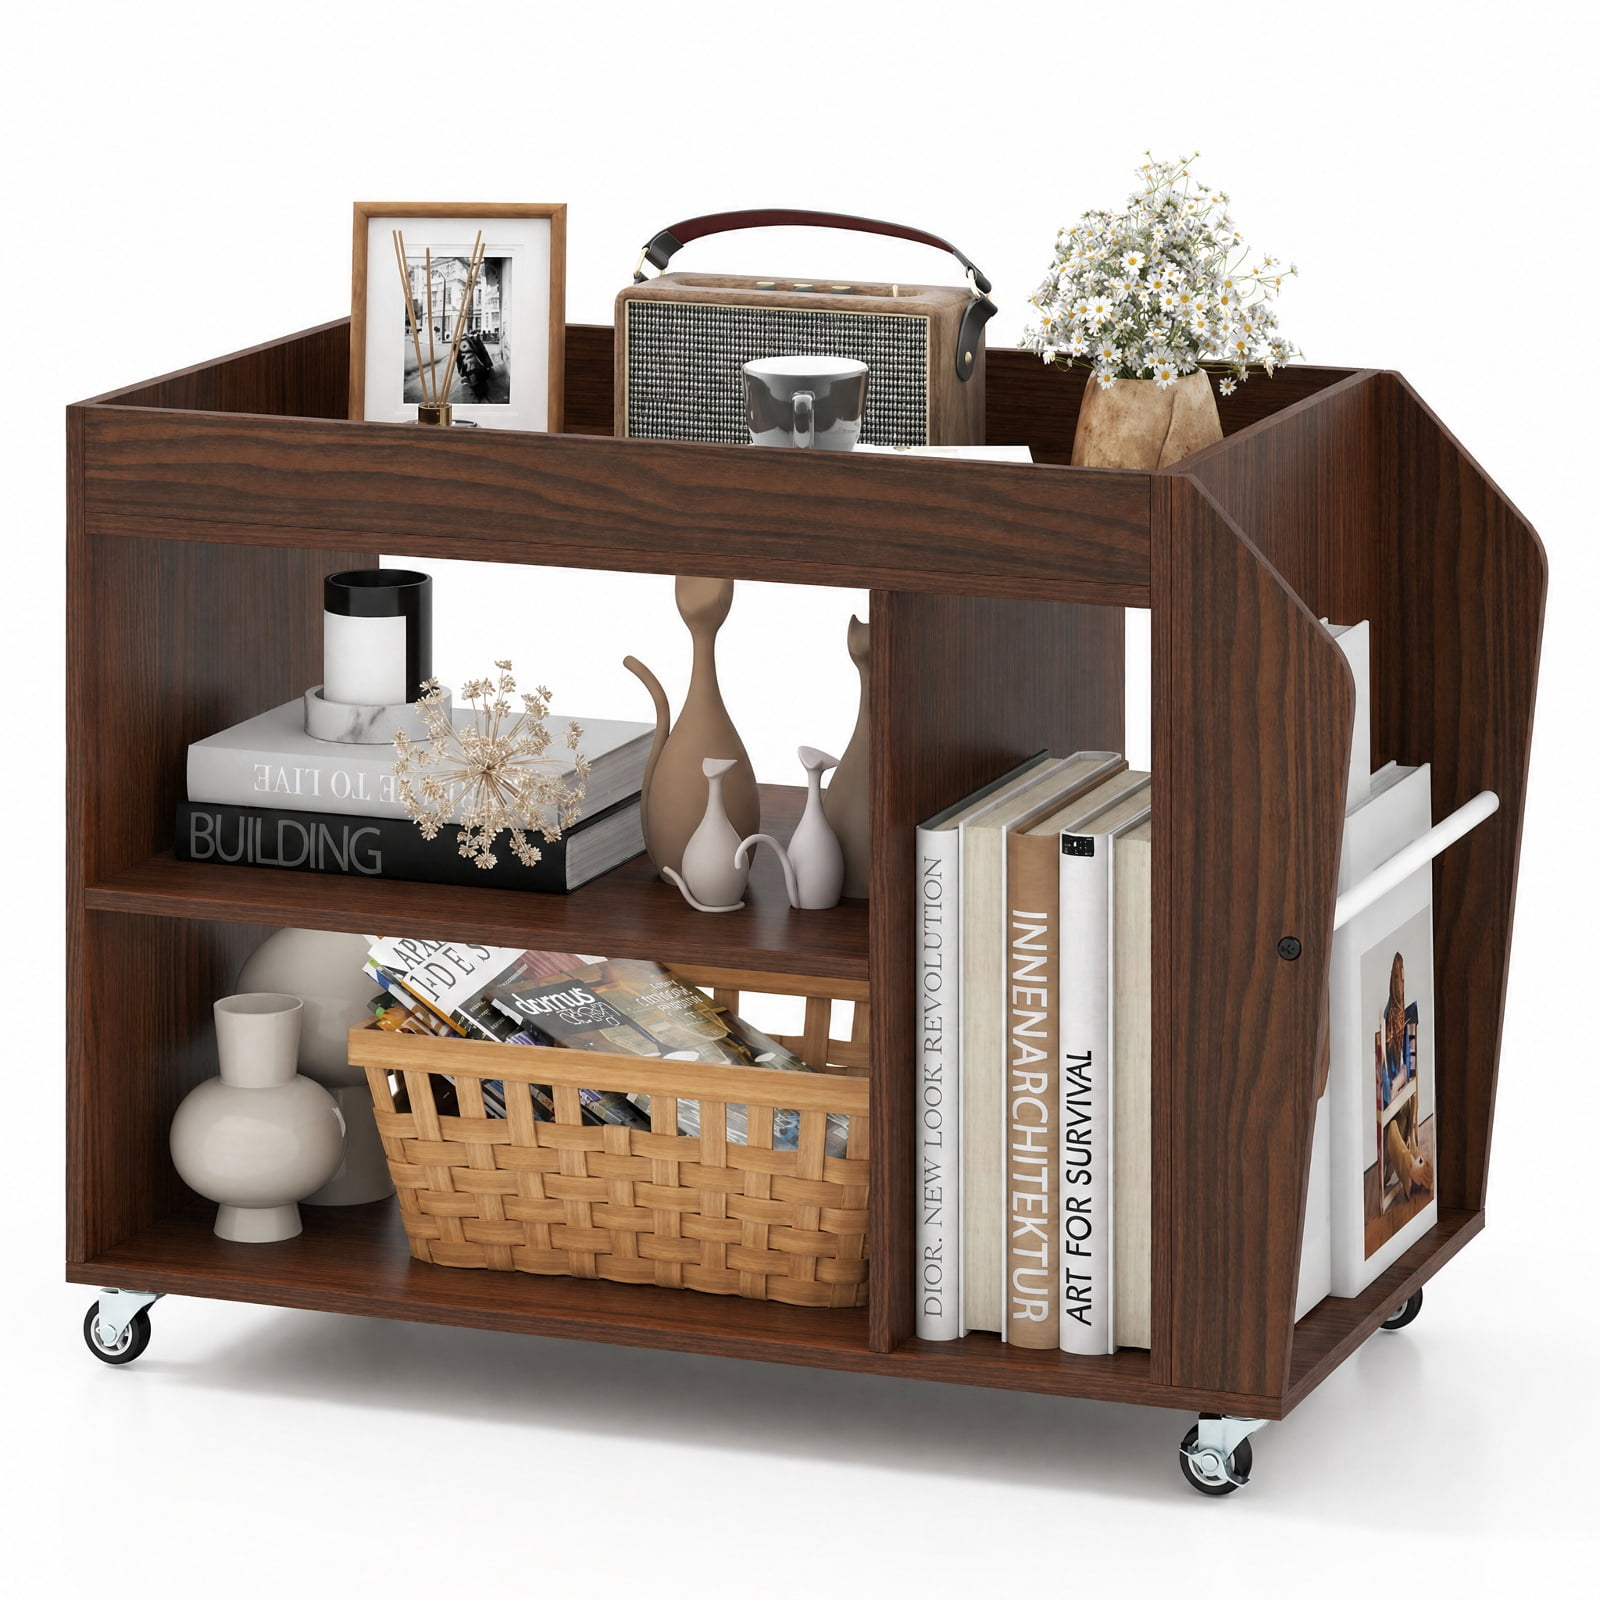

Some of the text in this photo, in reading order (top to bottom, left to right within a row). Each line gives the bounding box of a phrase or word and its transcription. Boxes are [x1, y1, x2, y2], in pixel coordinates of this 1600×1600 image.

[254, 763, 321, 797] LIVE
[331, 770, 371, 800] TO
[190, 811, 383, 875] BUILDING
[923, 856, 943, 1055] REVOLUTION
[923, 1063, 943, 1149] LOOK
[1012, 909, 1049, 1322] INNENARCHITEKTUR
[923, 1156, 943, 1228] NEW
[1065, 1050, 1092, 1327] ART FOR SURVIVAL
